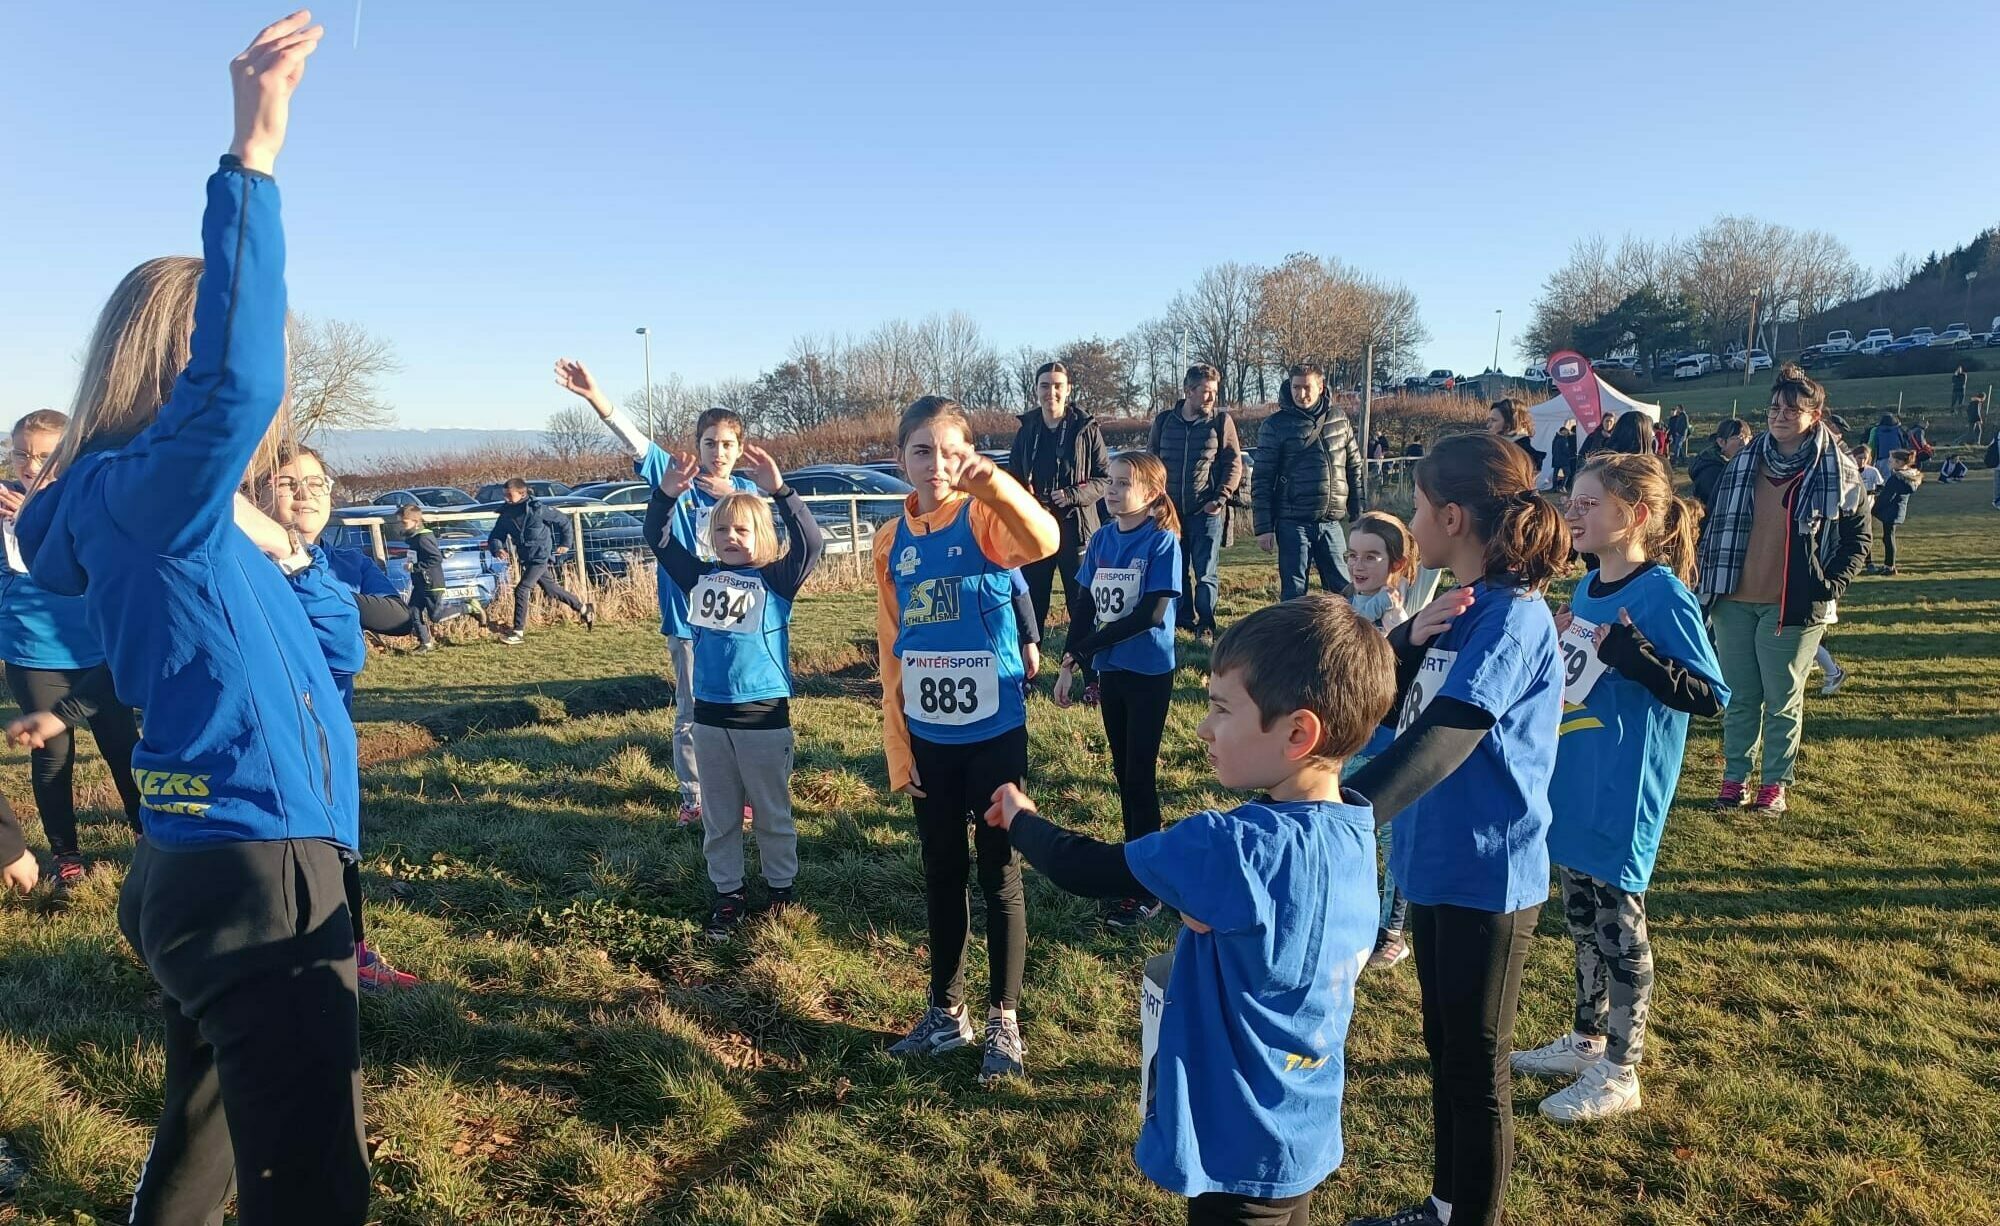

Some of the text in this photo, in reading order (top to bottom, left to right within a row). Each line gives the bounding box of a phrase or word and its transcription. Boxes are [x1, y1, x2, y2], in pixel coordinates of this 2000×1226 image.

[700, 588, 746, 624] 934
[905, 576, 962, 617] SAT
[916, 657, 992, 669] INTERSPORT
[1559, 640, 1588, 687] 79
[920, 677, 978, 714] 883
[130, 768, 212, 797] IERS
